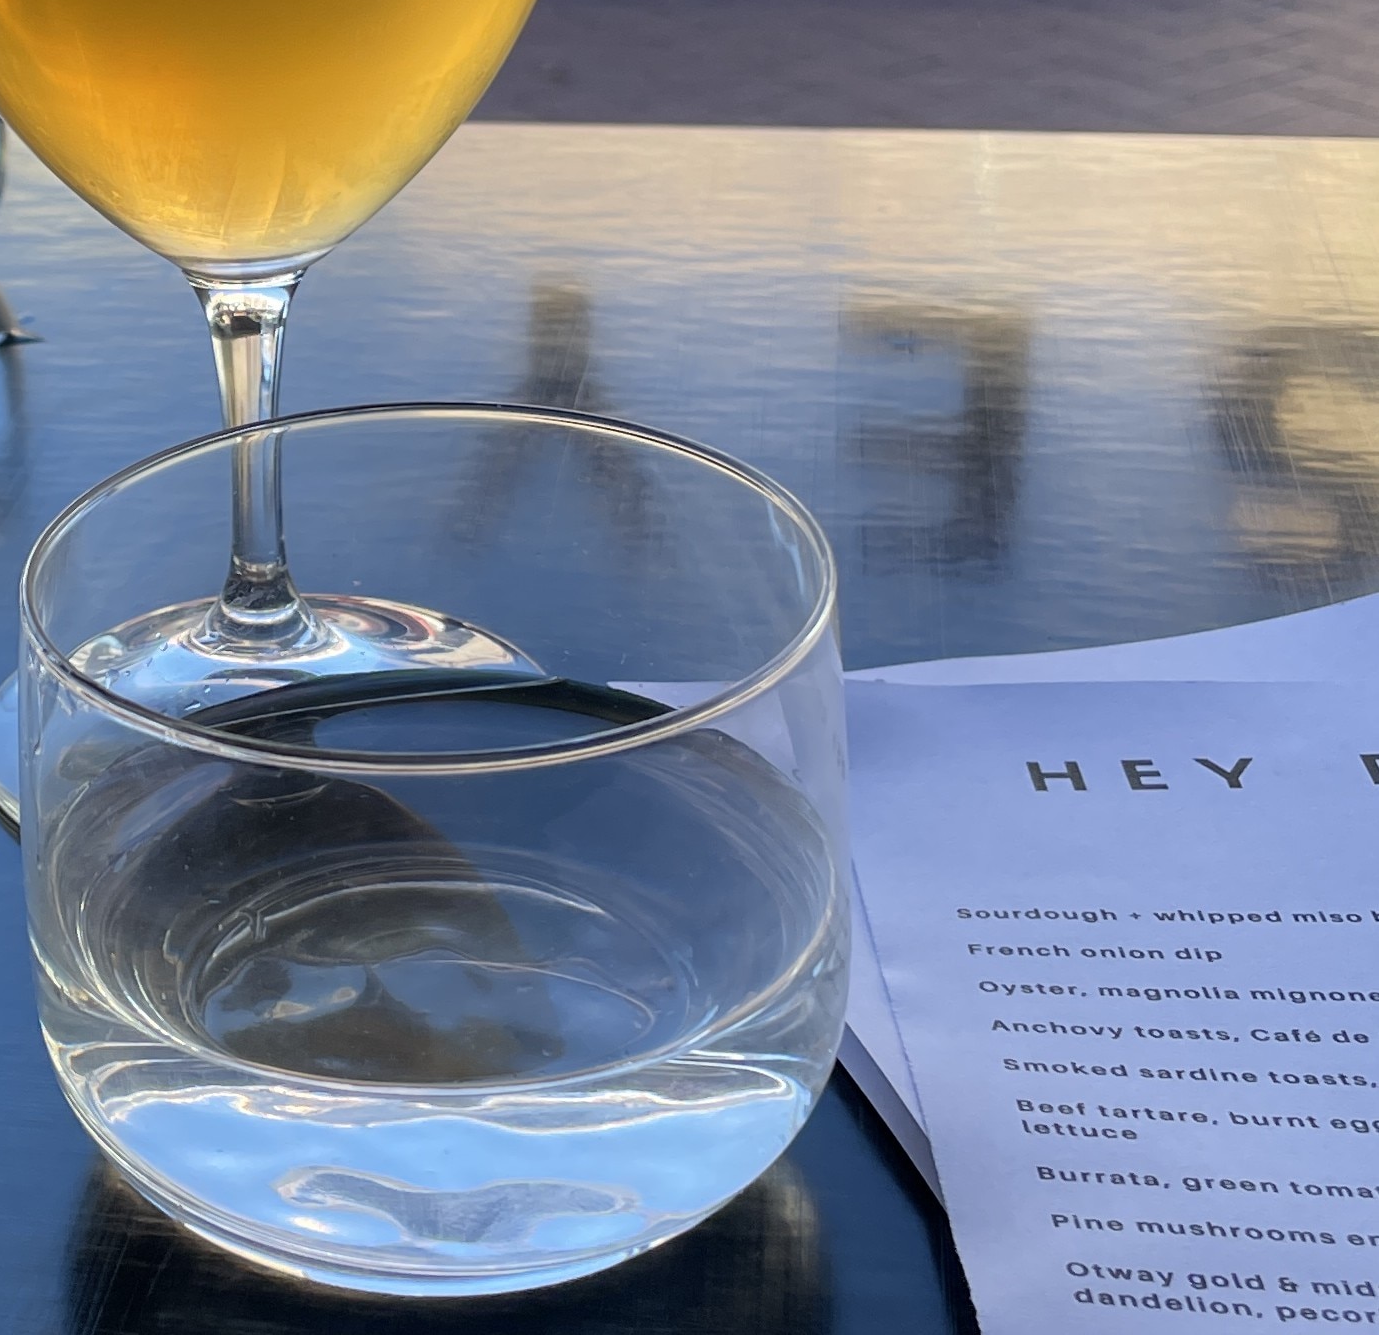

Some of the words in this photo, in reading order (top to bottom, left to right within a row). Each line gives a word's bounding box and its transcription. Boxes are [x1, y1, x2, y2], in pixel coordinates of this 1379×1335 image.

[1024, 757, 1254, 792] HEY
[956, 907, 1118, 924] Sourdough
[1152, 909, 1283, 925] whipped
[1290, 910, 1363, 923] miso
[967, 943, 1071, 958] French
[1079, 945, 1166, 961] onion
[1173, 946, 1223, 963] dip
[978, 980, 1088, 998] Oyster,
[1097, 983, 1241, 1002] magnolia
[991, 1019, 1124, 1040] Anchovy
[1132, 1025, 1240, 1043] toasts,
[1249, 1028, 1322, 1044] Café
[1331, 1029, 1370, 1044] de
[1002, 1058, 1129, 1078] Smoked
[1138, 1065, 1259, 1084] sardine
[1267, 1070, 1378, 1089] toasts,
[1015, 1098, 1086, 1116] Beef
[1095, 1104, 1219, 1126] tartare,
[1227, 1110, 1321, 1129] burnt
[1021, 1119, 1138, 1141] lettuce
[1035, 1165, 1171, 1190] Burrata,
[1181, 1176, 1280, 1194] green
[1050, 1213, 1125, 1232] Pine
[1134, 1220, 1337, 1245] mushrooms
[1065, 1261, 1175, 1288] Otway
[1186, 1272, 1267, 1292] gold
[1277, 1276, 1300, 1294] &
[1310, 1279, 1379, 1299] mid
[1073, 1287, 1264, 1319] dandelion,
[1274, 1304, 1379, 1325] pecor
